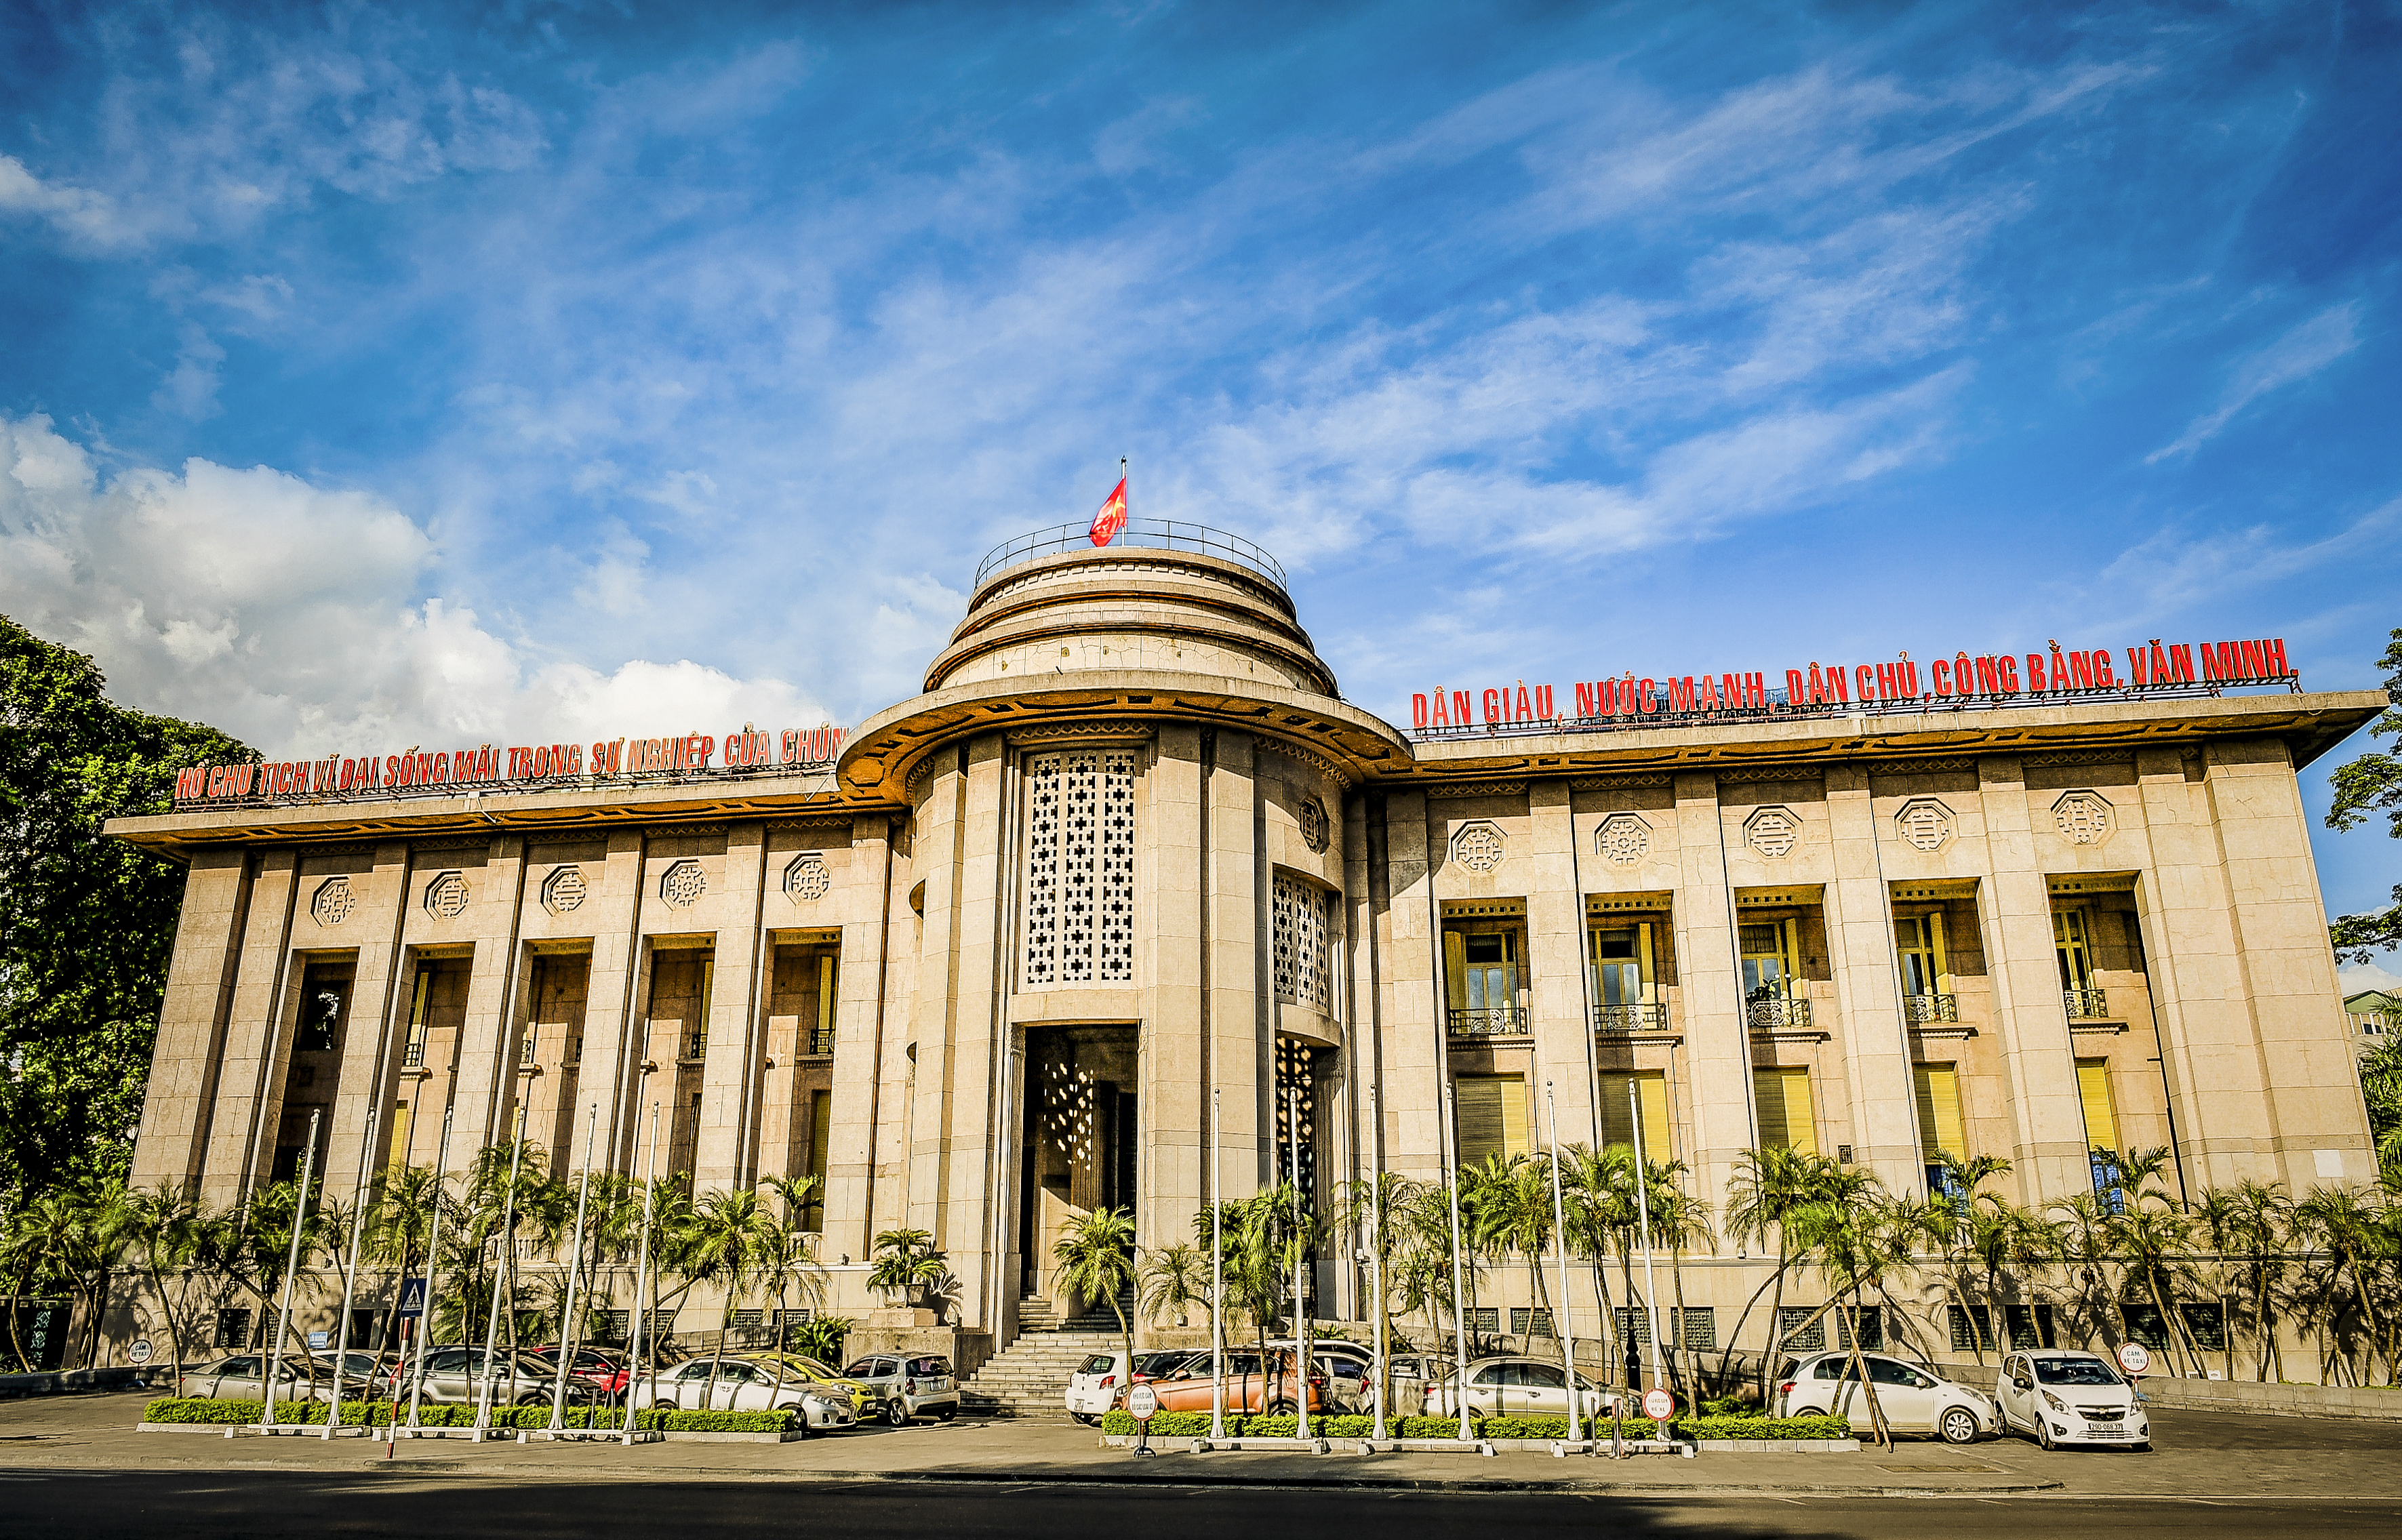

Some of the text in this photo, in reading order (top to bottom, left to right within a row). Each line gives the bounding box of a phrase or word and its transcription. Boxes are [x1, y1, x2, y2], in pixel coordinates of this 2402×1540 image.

[1412, 685, 1471, 727] DÂN
[1483, 679, 1563, 724] GIÀU,
[1575, 670, 1657, 718] NƯỚC
[1668, 671, 1776, 719] MẠNH,
[1786, 661, 1849, 706] DÂN
[1856, 651, 1931, 703] CHỦ,
[1932, 651, 2020, 696] CÔNG
[2026, 639, 2124, 691] BẰNG,
[2127, 639, 2195, 685] VĂN
[175, 758, 209, 799] HỒ
[208, 755, 254, 798] CHỦ
[258, 761, 311, 800] TỊCH
[313, 753, 340, 792] VĨ
[340, 756, 380, 795] ĐẠI
[383, 745, 449, 786] SỐNG
[452, 744, 500, 782] MÃI
[507, 744, 582, 779] TRONG
[590, 737, 624, 779] SỰ
[626, 730, 715, 775] NGHIỆP
[723, 721, 771, 768] CỦA
